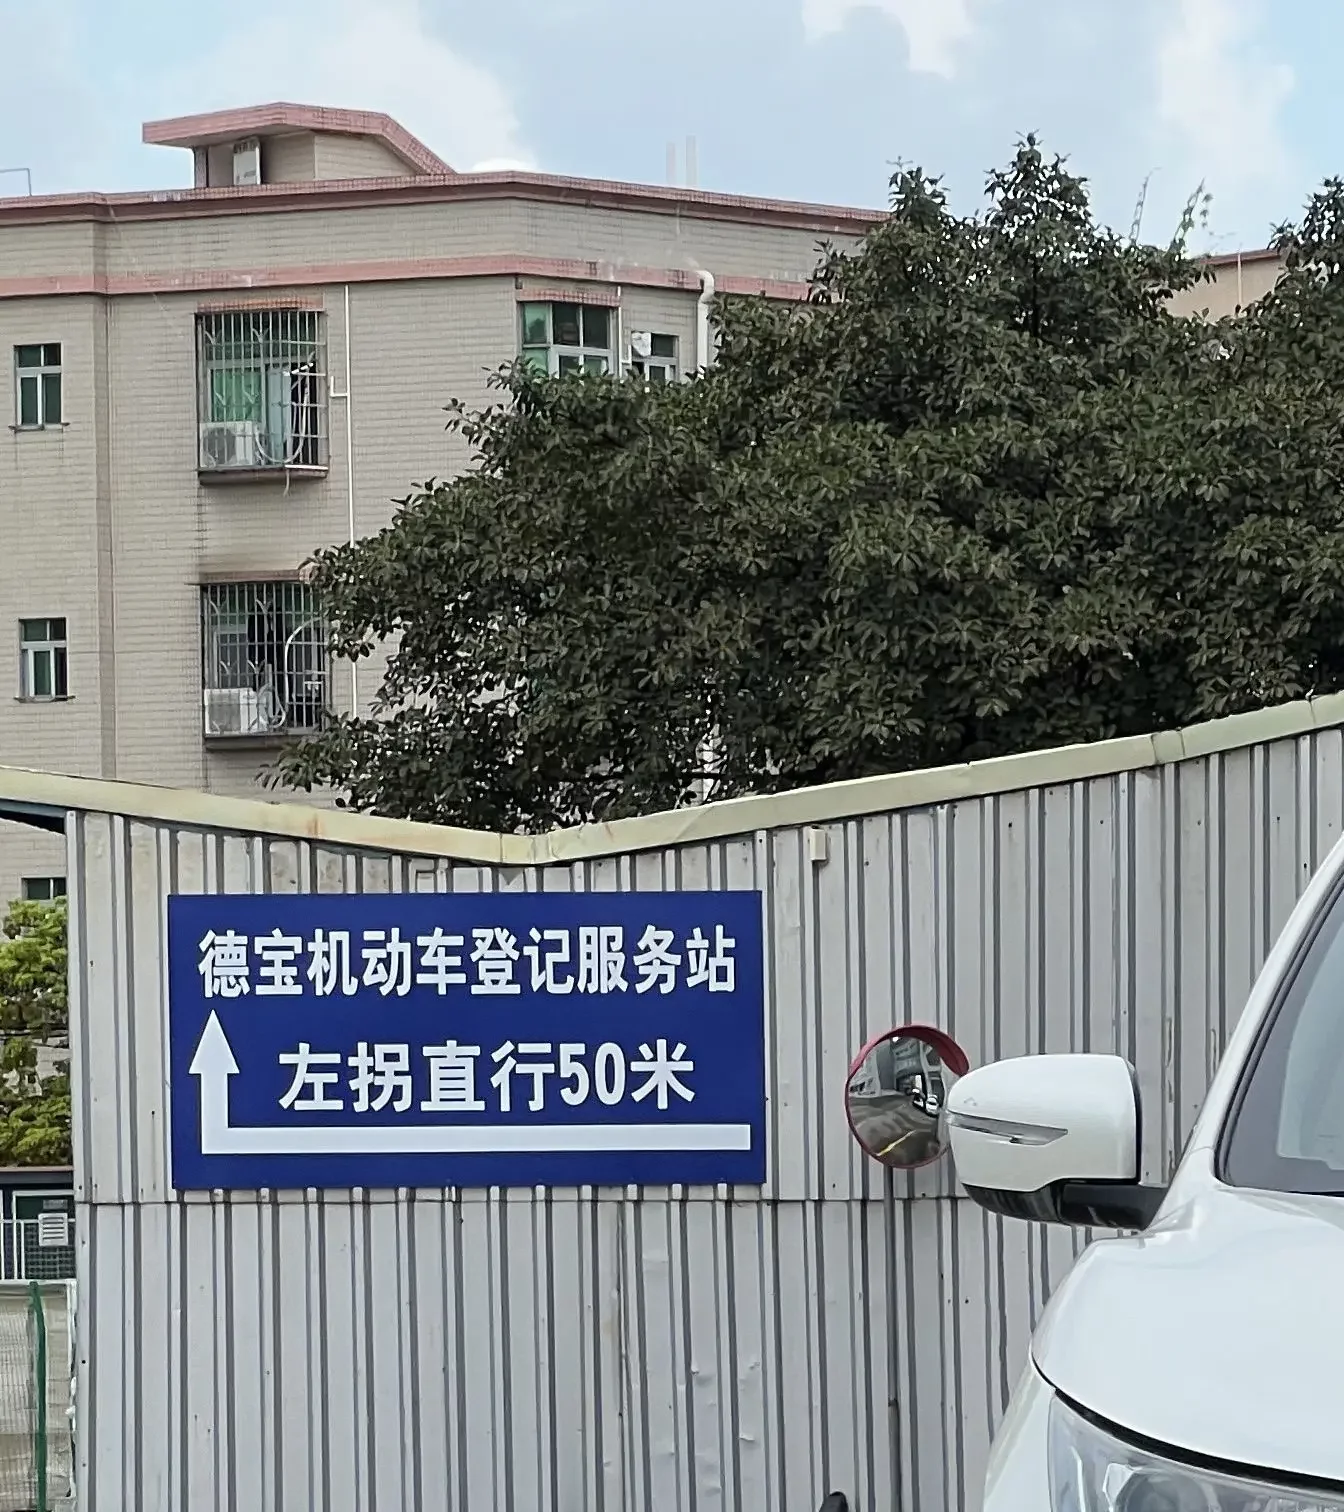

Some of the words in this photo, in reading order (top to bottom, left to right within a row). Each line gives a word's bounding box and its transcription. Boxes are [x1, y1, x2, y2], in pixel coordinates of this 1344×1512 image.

[198, 925, 735, 997] 德宝机动车登记服务站
[279, 1039, 694, 1112] 左拐直行50米
